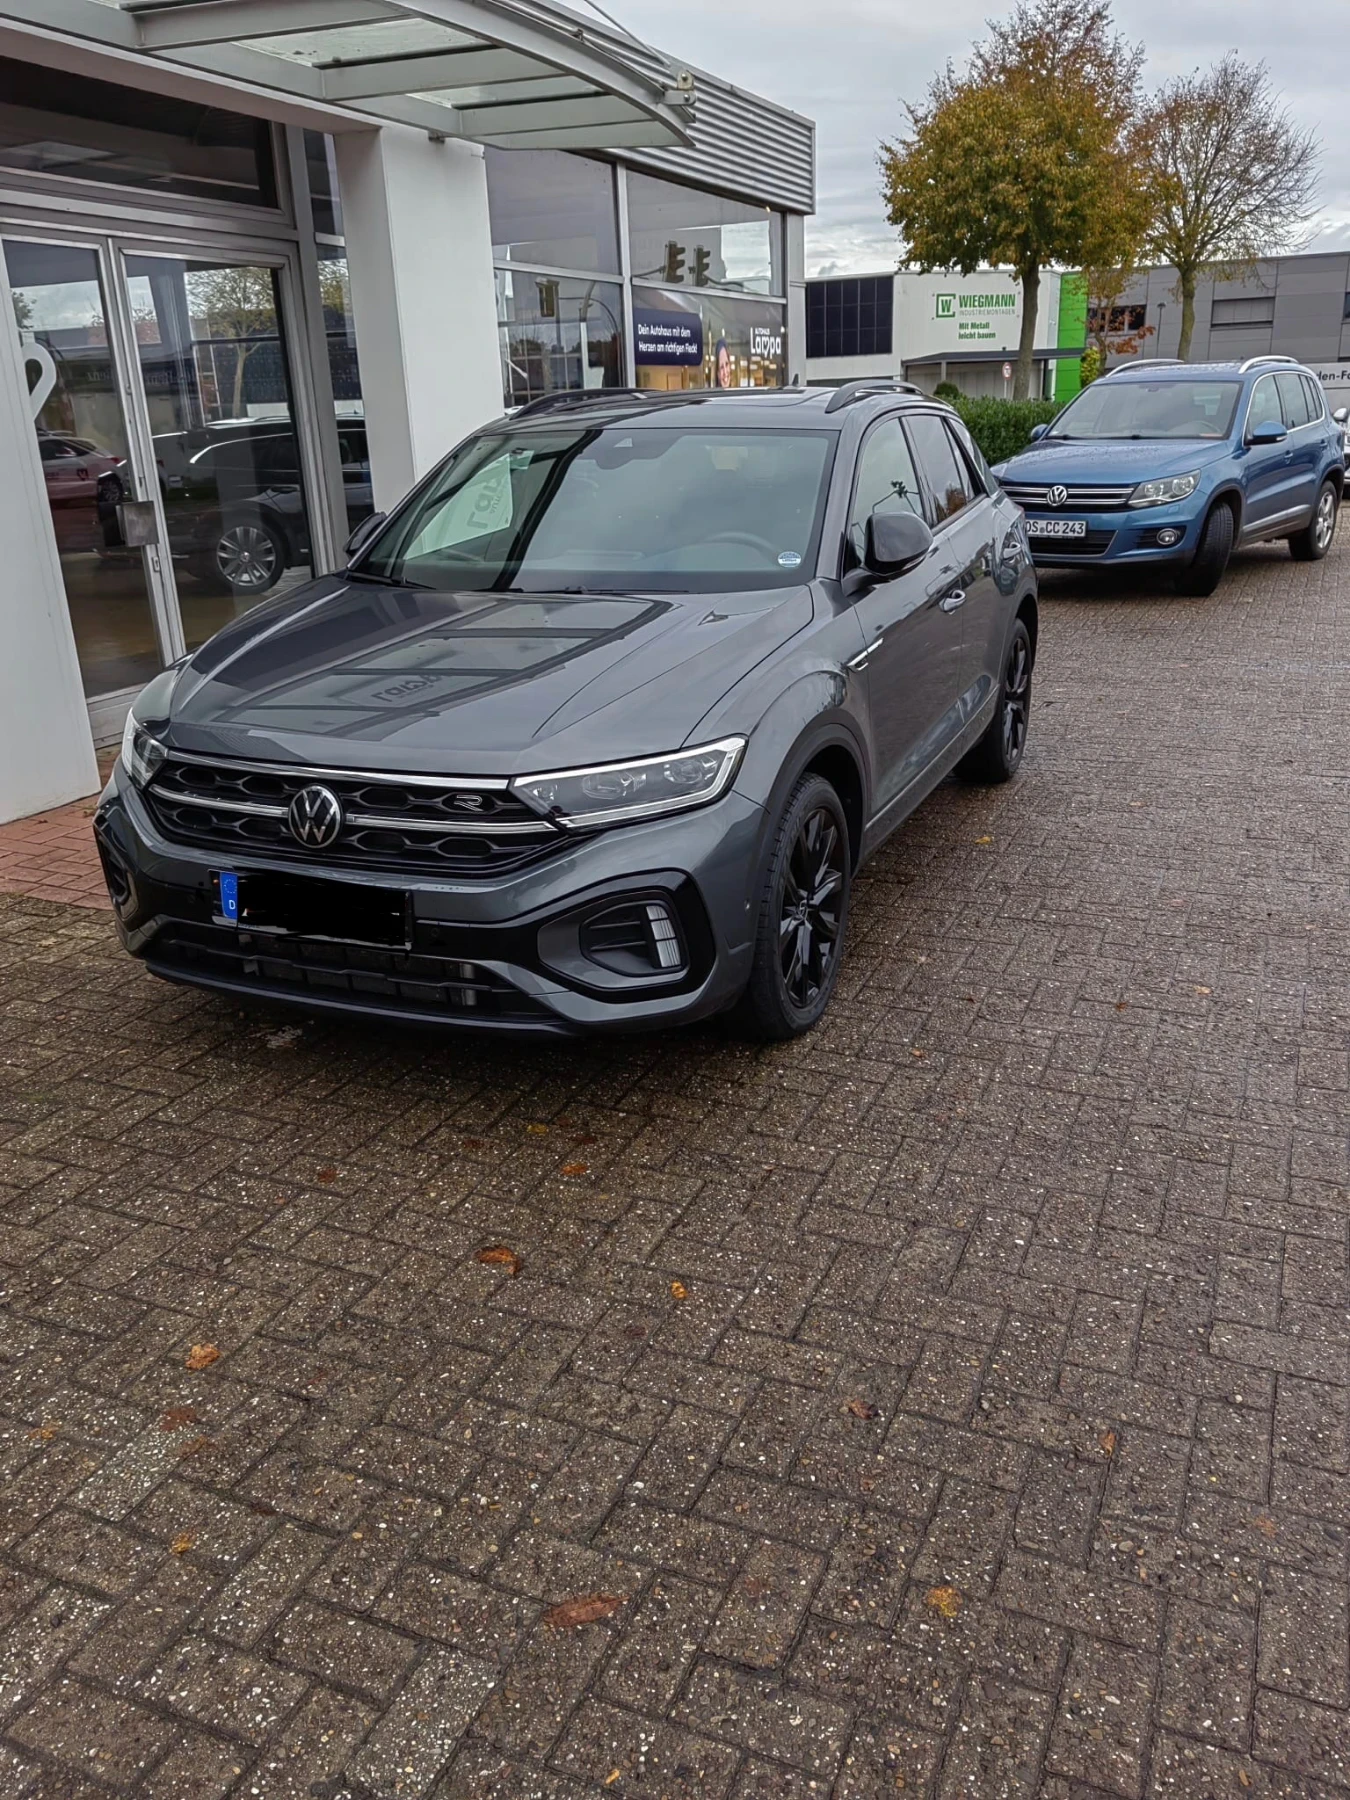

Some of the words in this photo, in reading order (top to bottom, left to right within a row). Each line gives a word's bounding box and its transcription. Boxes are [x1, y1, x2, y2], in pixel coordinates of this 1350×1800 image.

[959, 294, 1015, 308] WIEGMANN
[638, 324, 649, 335] Dein
[650, 324, 672, 336] Autohaus
[672, 326, 680, 337] mit
[681, 326, 691, 337] dem
[959, 322, 969, 330] Mit
[971, 322, 990, 330] Metall
[638, 341, 656, 352] Herzen
[657, 344, 664, 352] am
[665, 341, 684, 355] richtigen
[750, 327, 781, 359] Lampa
[1045, 521, 1060, 534] CC
[1062, 522, 1085, 534] 243
[229, 900, 236, 910] D
